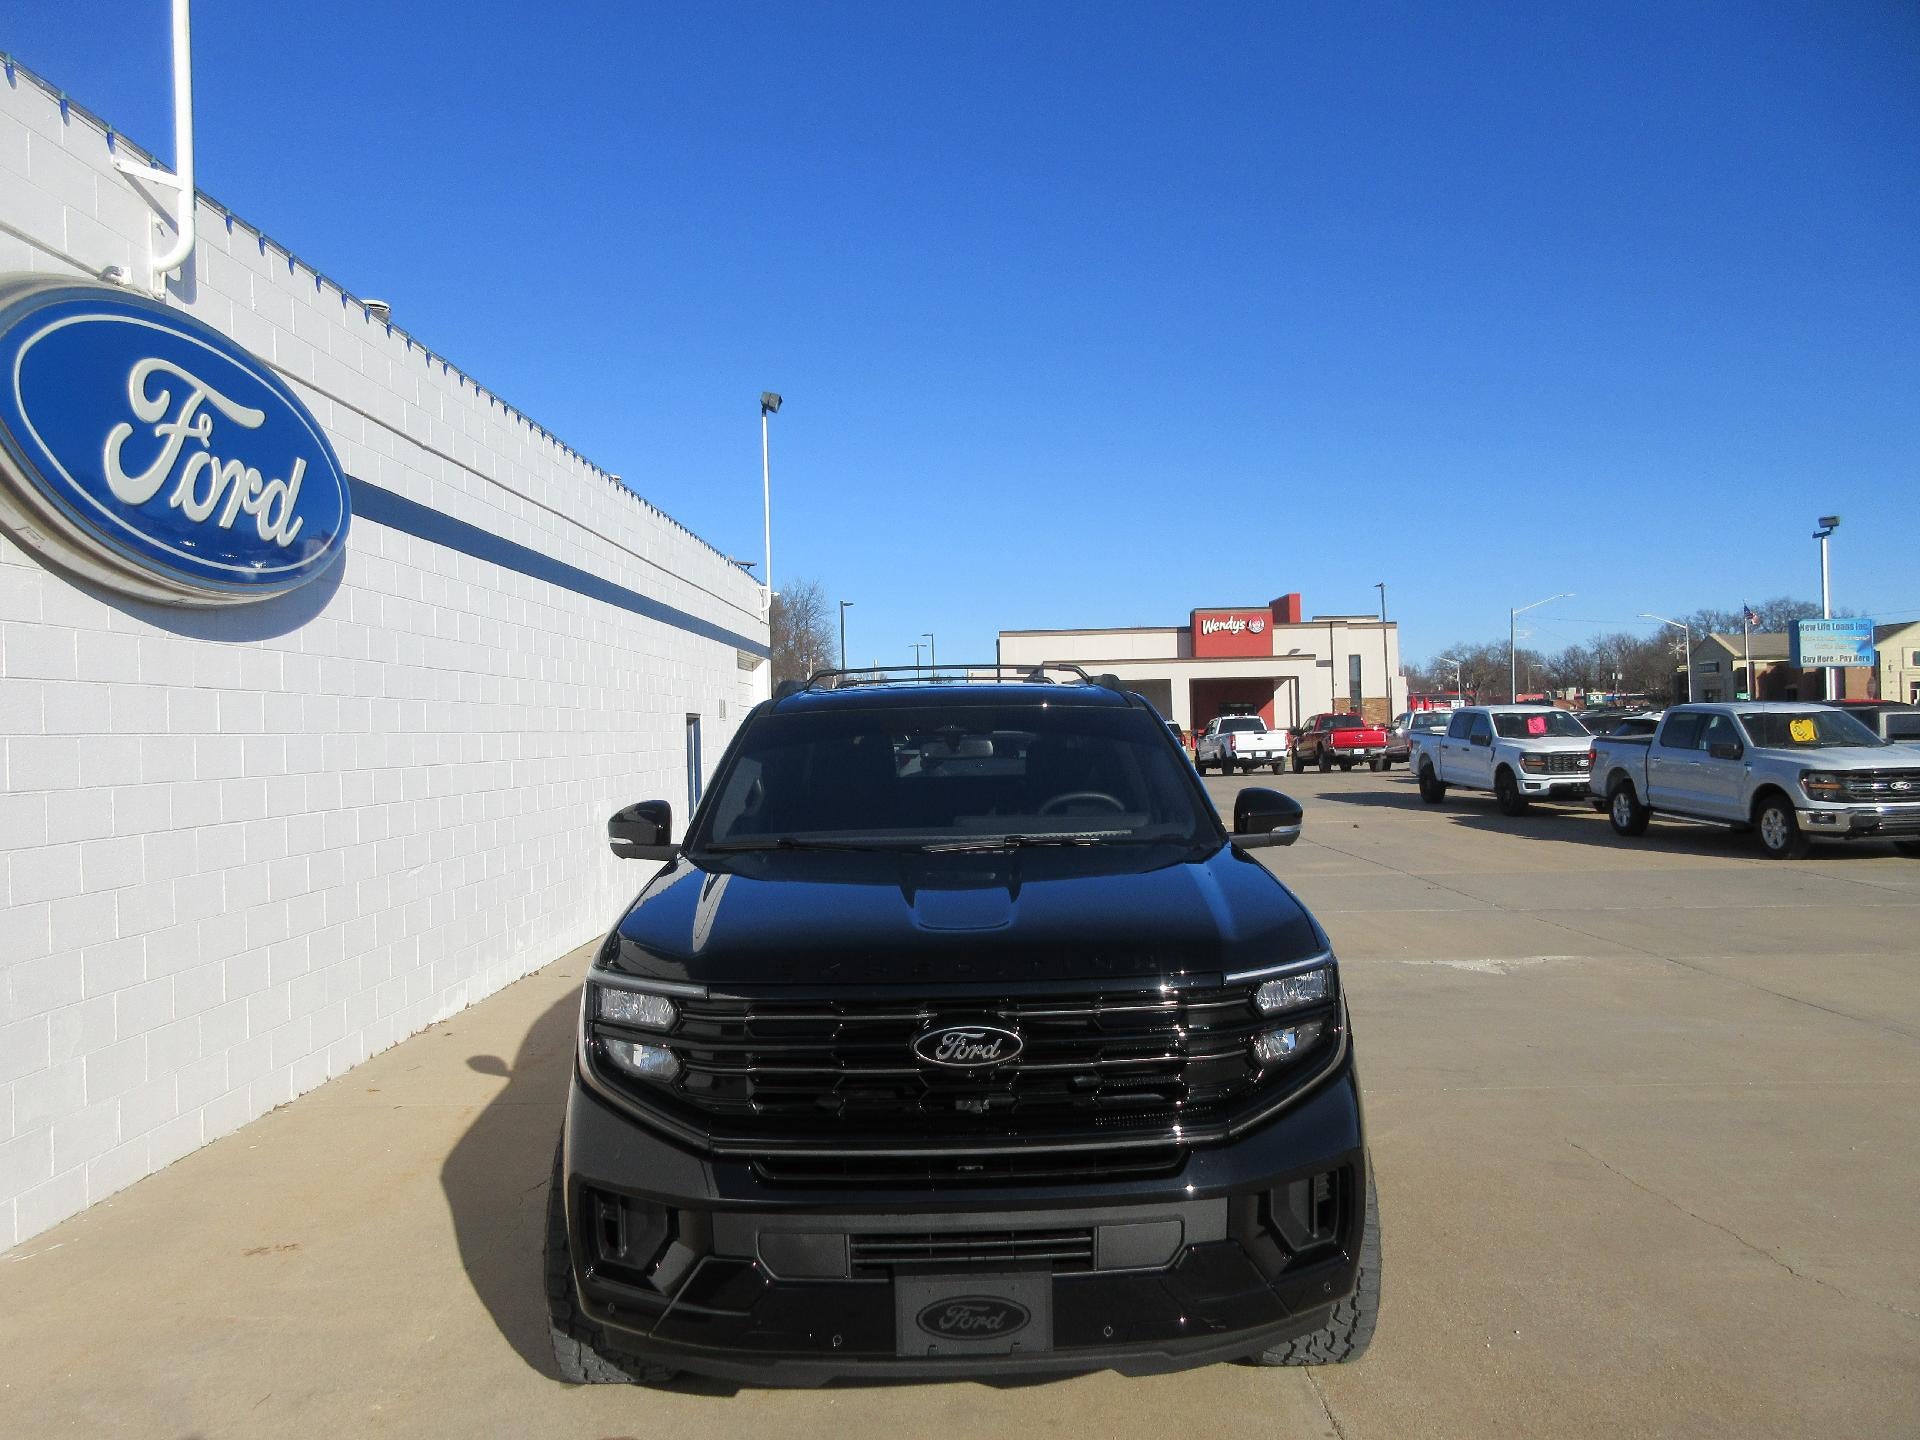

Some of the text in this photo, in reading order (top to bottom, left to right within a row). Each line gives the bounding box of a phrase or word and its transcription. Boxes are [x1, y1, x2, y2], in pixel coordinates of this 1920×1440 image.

[103, 358, 307, 547] Ford
[1202, 616, 1245, 635] Wendy's
[1800, 623, 1815, 631] New
[1818, 623, 1830, 631] Life
[1833, 622, 1854, 631] Loans
[1803, 655, 1816, 663] Buy
[1840, 655, 1853, 663] Pay
[936, 1032, 1002, 1060] Ford
[939, 1304, 1006, 1329] Ford
